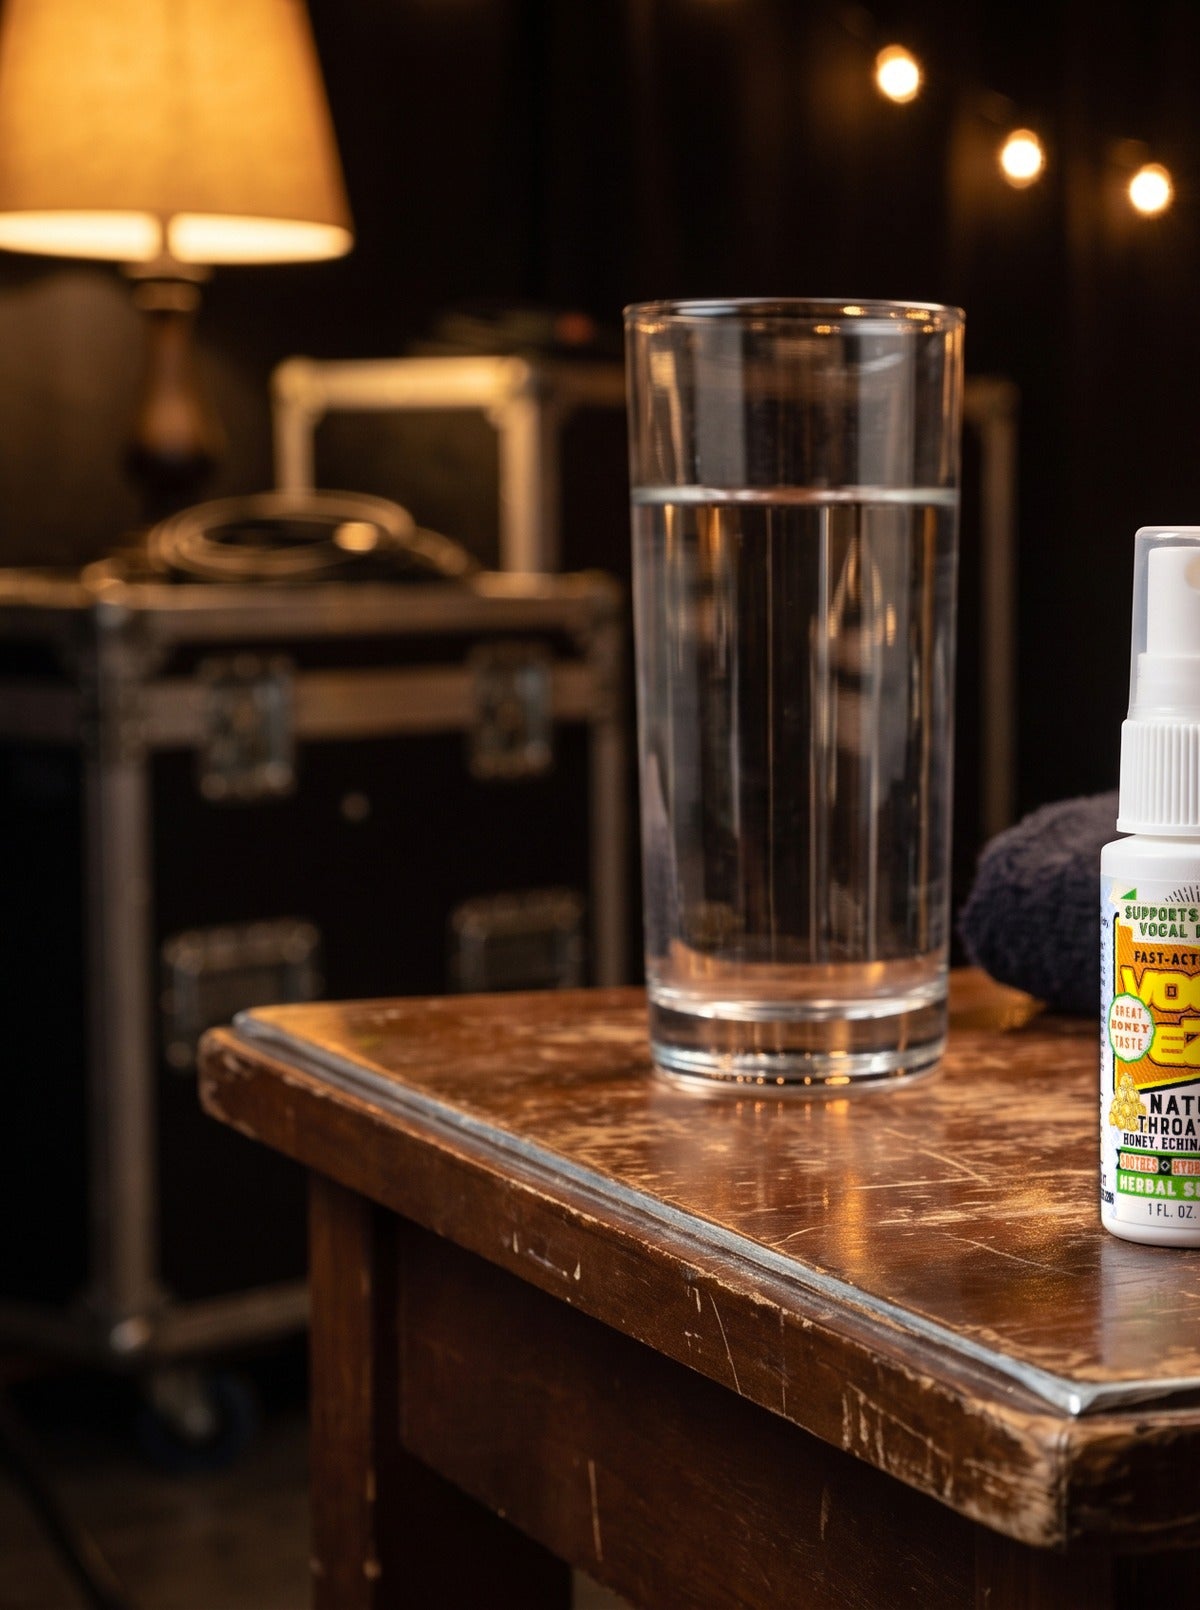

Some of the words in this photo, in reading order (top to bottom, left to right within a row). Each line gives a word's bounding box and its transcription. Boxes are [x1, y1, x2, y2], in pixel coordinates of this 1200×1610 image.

[1125, 905, 1199, 922] SUPPORTS
[1139, 923, 1188, 938] VOCAL
[1115, 1005, 1142, 1019] GREAT
[1111, 1021, 1150, 1034] HONEY
[1115, 1035, 1143, 1051] TASTE
[1123, 1133, 1158, 1150] HONEY,
[1120, 1154, 1158, 1172] SOOTHES
[1120, 1177, 1176, 1197] HERBAL
[1148, 1203, 1152, 1215] 1
[1157, 1204, 1173, 1218] FL.
[1178, 1206, 1197, 1219] OZ.
